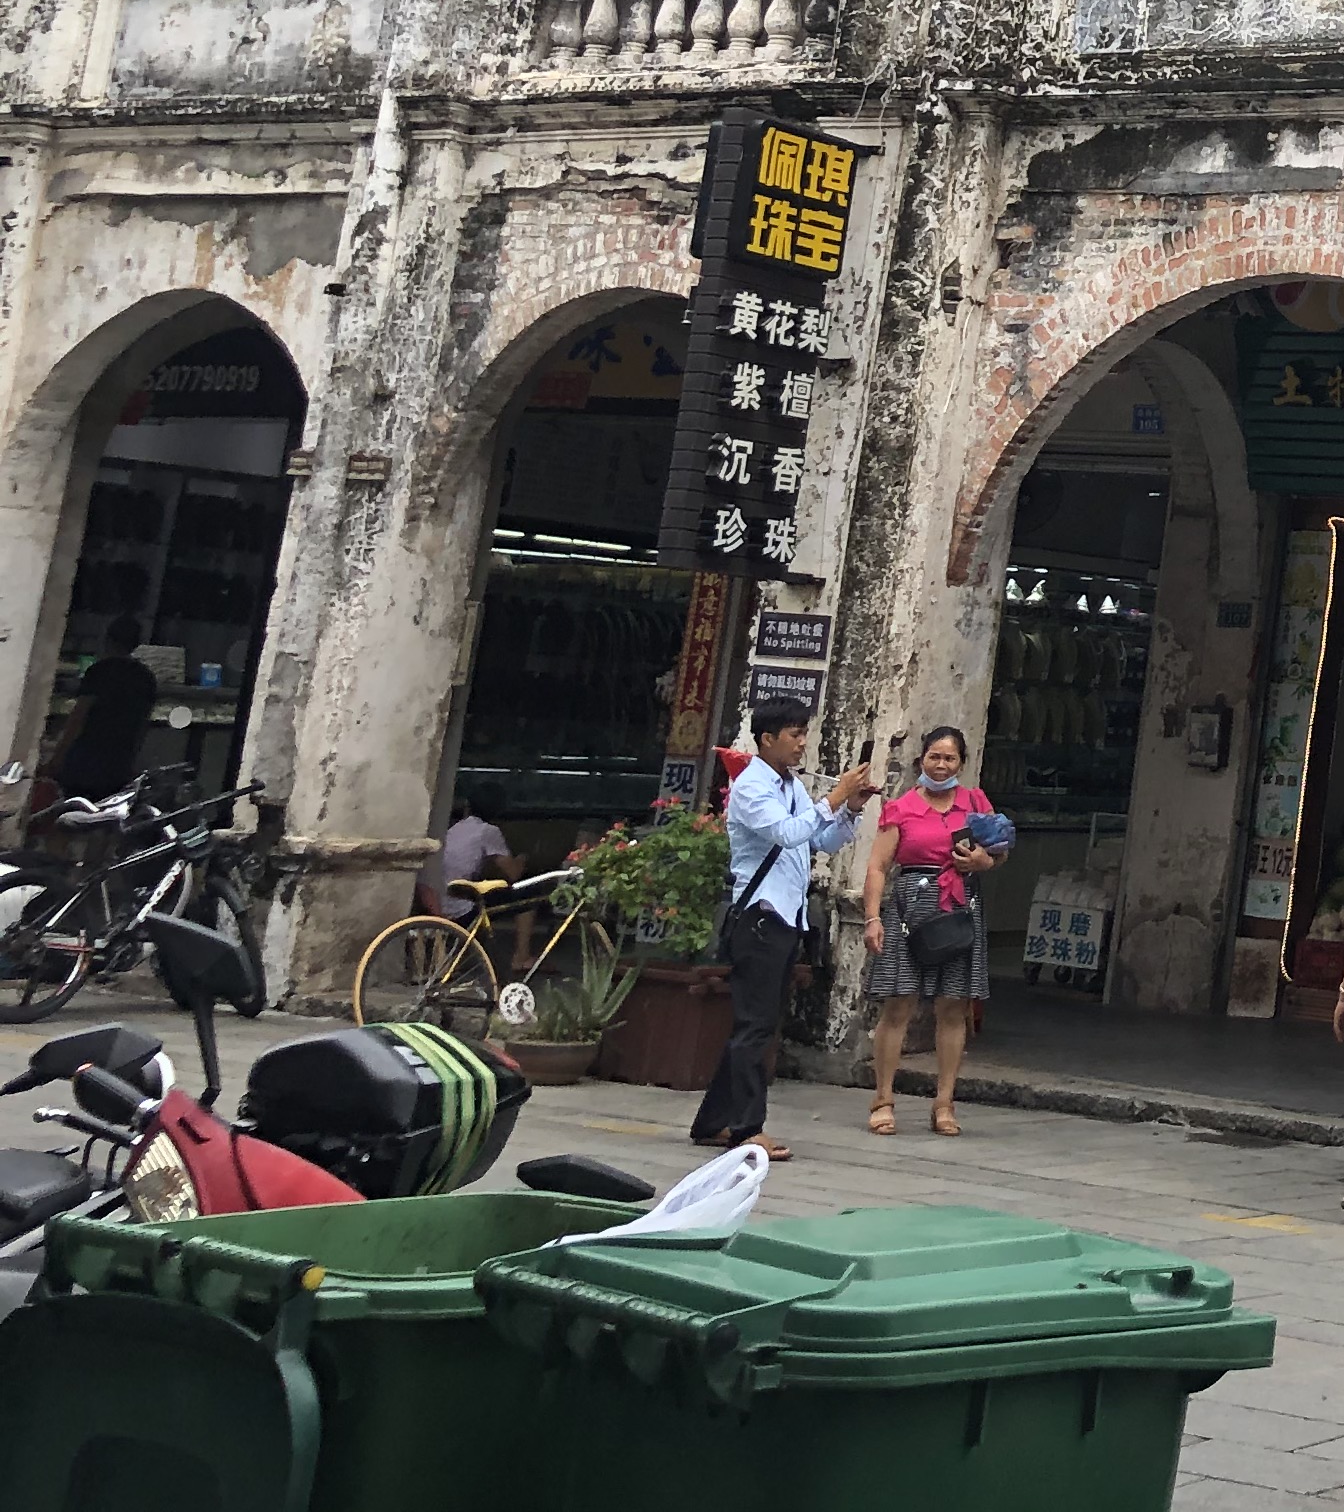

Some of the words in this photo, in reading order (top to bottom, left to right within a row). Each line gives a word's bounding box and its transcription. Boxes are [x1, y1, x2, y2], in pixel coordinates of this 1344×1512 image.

[757, 125, 855, 207] 佩琪
[746, 193, 845, 273] 珠宝
[731, 291, 832, 355] 黄花梨
[731, 361, 814, 420] 紫檀
[719, 435, 806, 494] 沉香
[713, 507, 798, 565] 珍珠
[763, 636, 779, 648] No
[780, 637, 821, 653] Spitting
[756, 689, 771, 700] No
[1026, 934, 1098, 966] 珍珠粉
[1040, 908, 1093, 937] 现磨
